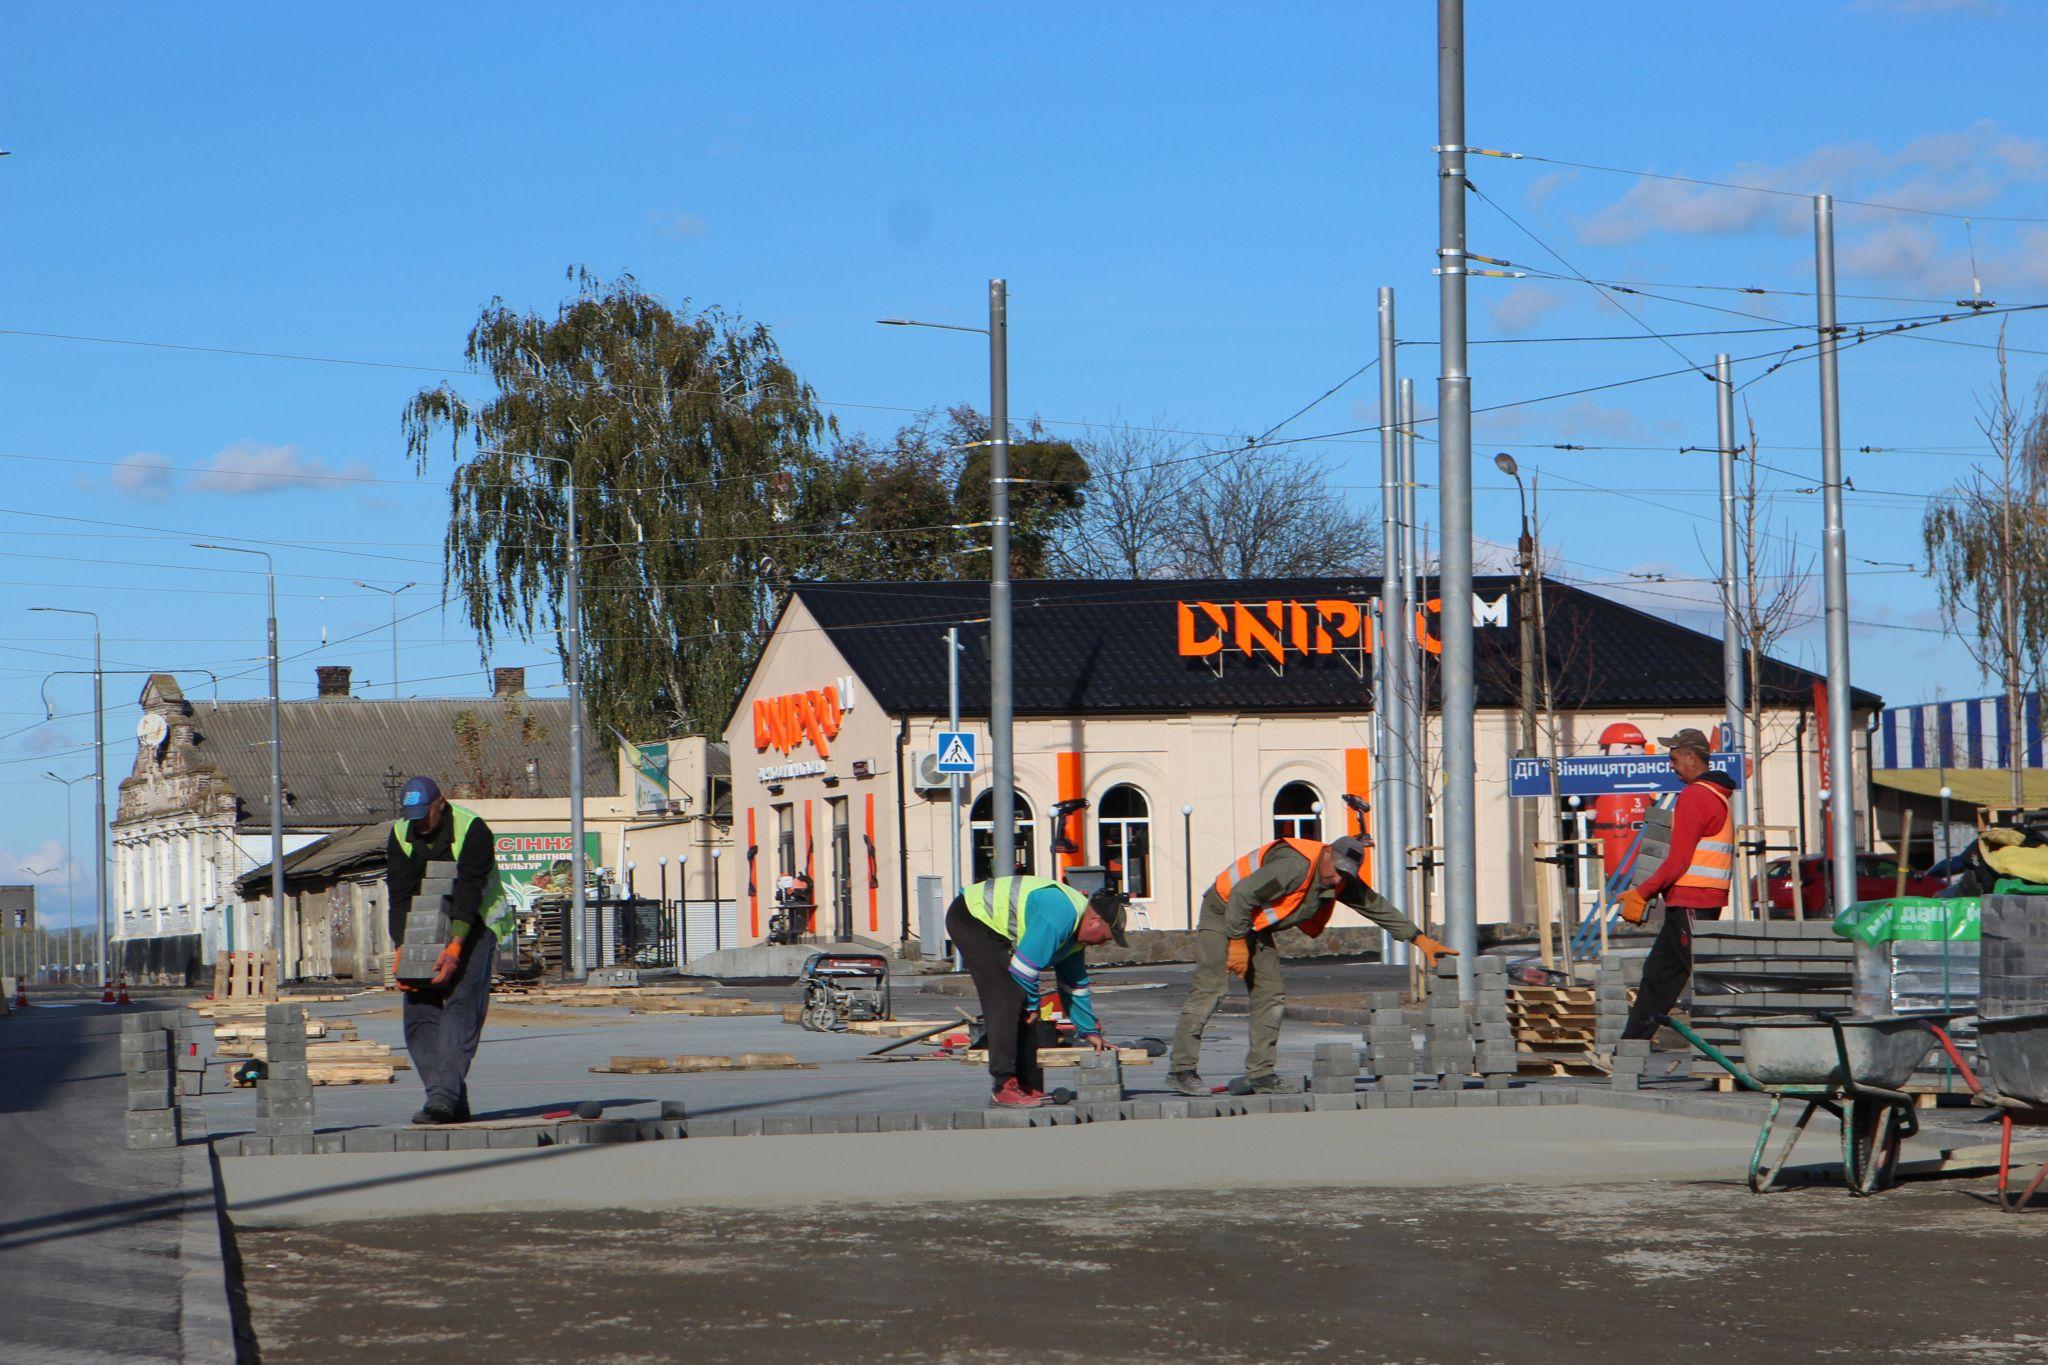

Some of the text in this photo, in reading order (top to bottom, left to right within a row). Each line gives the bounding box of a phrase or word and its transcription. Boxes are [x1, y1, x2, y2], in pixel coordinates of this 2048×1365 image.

[1515, 761, 1540, 780] ДП
[511, 853, 524, 861] ТА
[497, 862, 542, 871] КУЛЬТУР
